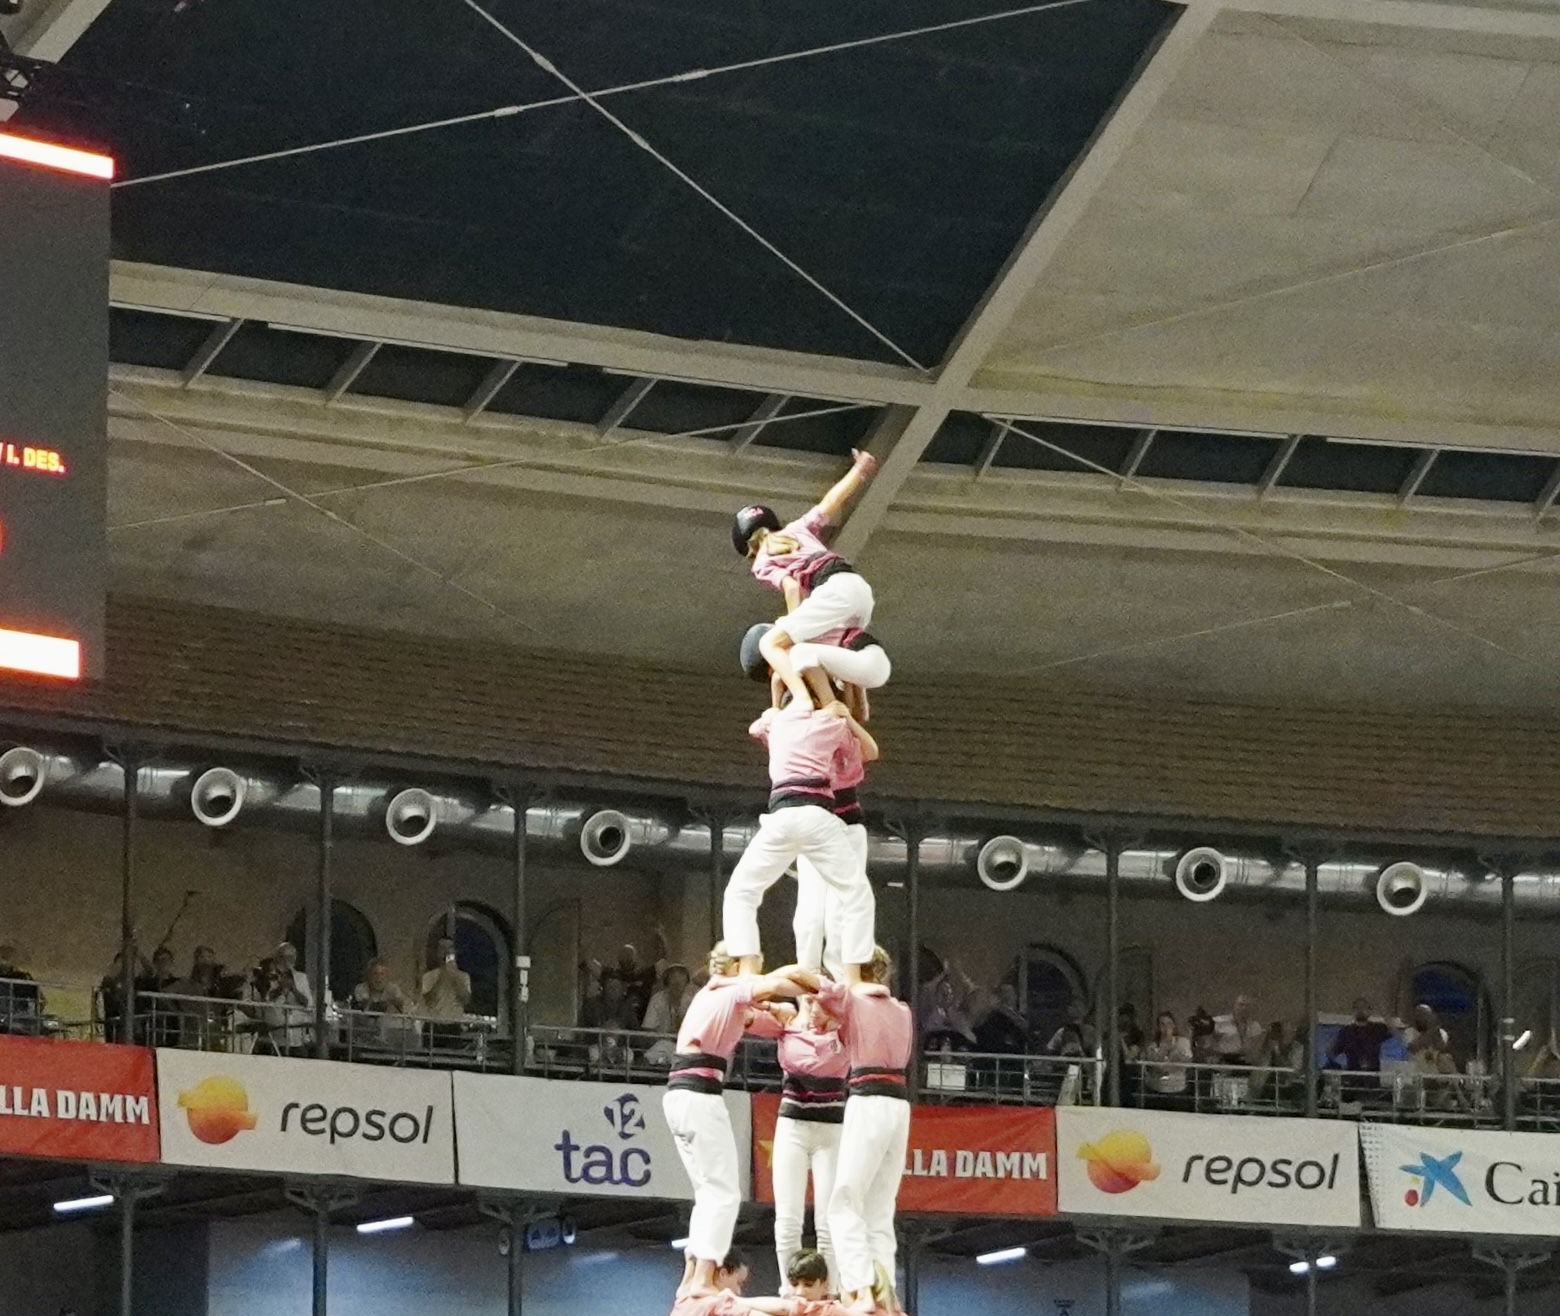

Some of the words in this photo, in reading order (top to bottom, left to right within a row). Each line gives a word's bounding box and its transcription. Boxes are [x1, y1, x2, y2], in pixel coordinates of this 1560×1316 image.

[23, 447, 65, 474] DES.
[56, 1090, 150, 1126] DAMM
[280, 1102, 433, 1145] repsol
[555, 1129, 651, 1187] tac
[954, 1150, 1048, 1180] DAMM
[1181, 1153, 1339, 1195] repsol
